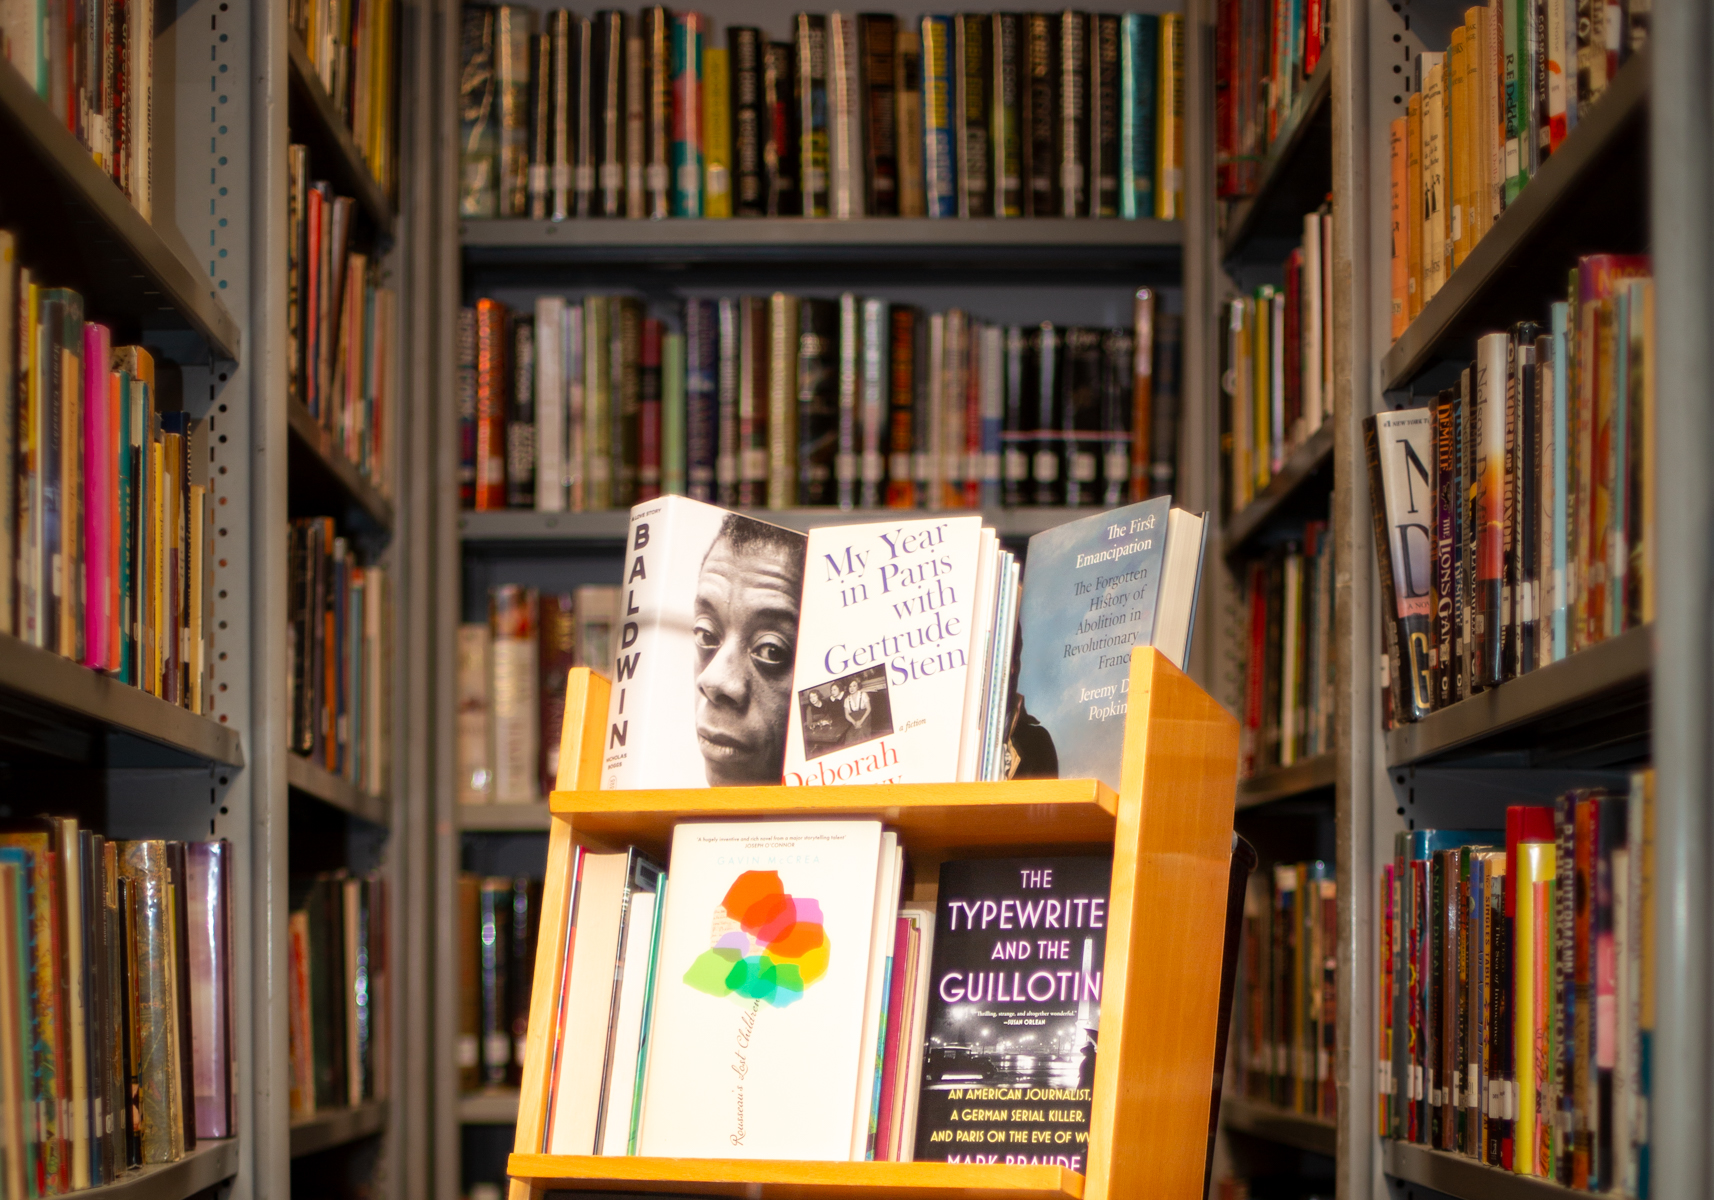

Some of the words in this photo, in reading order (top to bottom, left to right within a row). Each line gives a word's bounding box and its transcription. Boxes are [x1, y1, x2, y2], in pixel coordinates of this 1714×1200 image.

[1392, 420, 1407, 428] NEW
[1407, 418, 1423, 427] YORK
[1505, 378, 1516, 451] WORD
[634, 511, 646, 521] LOVE
[646, 507, 662, 517] STORY
[1107, 523, 1126, 541] The
[1129, 514, 1156, 536] First
[1503, 474, 1514, 553] HONOR
[823, 545, 871, 583] My
[879, 524, 949, 561] Year
[1075, 538, 1153, 570] Emancipation
[840, 577, 869, 608] in
[879, 548, 954, 595] Paris
[1073, 580, 1093, 597] The
[1094, 567, 1148, 593] Forgotten
[892, 578, 958, 621] with
[1088, 592, 1131, 613] History
[1133, 584, 1148, 602] of
[609, 523, 650, 750] BALDWIN
[1075, 611, 1127, 637] Abolition
[1130, 607, 1142, 622] in
[823, 612, 963, 675] Gertrude
[1062, 629, 1141, 660] Revolutionary
[890, 642, 967, 687] Stein
[1078, 681, 1118, 705] Jeremy
[904, 718, 927, 733] fiction
[1088, 700, 1128, 722] Popkin
[781, 741, 900, 786] Deborah
[702, 836, 719, 844] hugely
[804, 834, 830, 842] storytelling
[717, 856, 760, 865] GAVIN
[1020, 869, 1053, 889] THE
[948, 898, 1105, 931] TYPEWRITE
[991, 941, 1031, 960] AND
[1037, 940, 1070, 959] THE
[939, 971, 1102, 1003] GUILLOTIN
[736, 998, 761, 1049] Children
[1023, 1018, 1046, 1026] ORLEAN
[1026, 1010, 1050, 1018] altogether
[730, 1051, 748, 1081] Lost
[947, 1088, 963, 1100] AN
[965, 1088, 1022, 1100] AMERICAN
[1024, 1088, 1092, 1102] JOURNALIST,
[950, 1109, 959, 1121] A
[961, 1109, 1008, 1122] GERMAN
[1010, 1109, 1045, 1122] SERIAL
[1048, 1110, 1086, 1123] KILLER,
[930, 1130, 953, 1142] AND
[956, 1130, 984, 1142] PARIS
[987, 1130, 1006, 1143] ON
[1009, 1131, 1028, 1143] THE
[1031, 1131, 1052, 1143] EVE
[1054, 1131, 1072, 1144] OF
